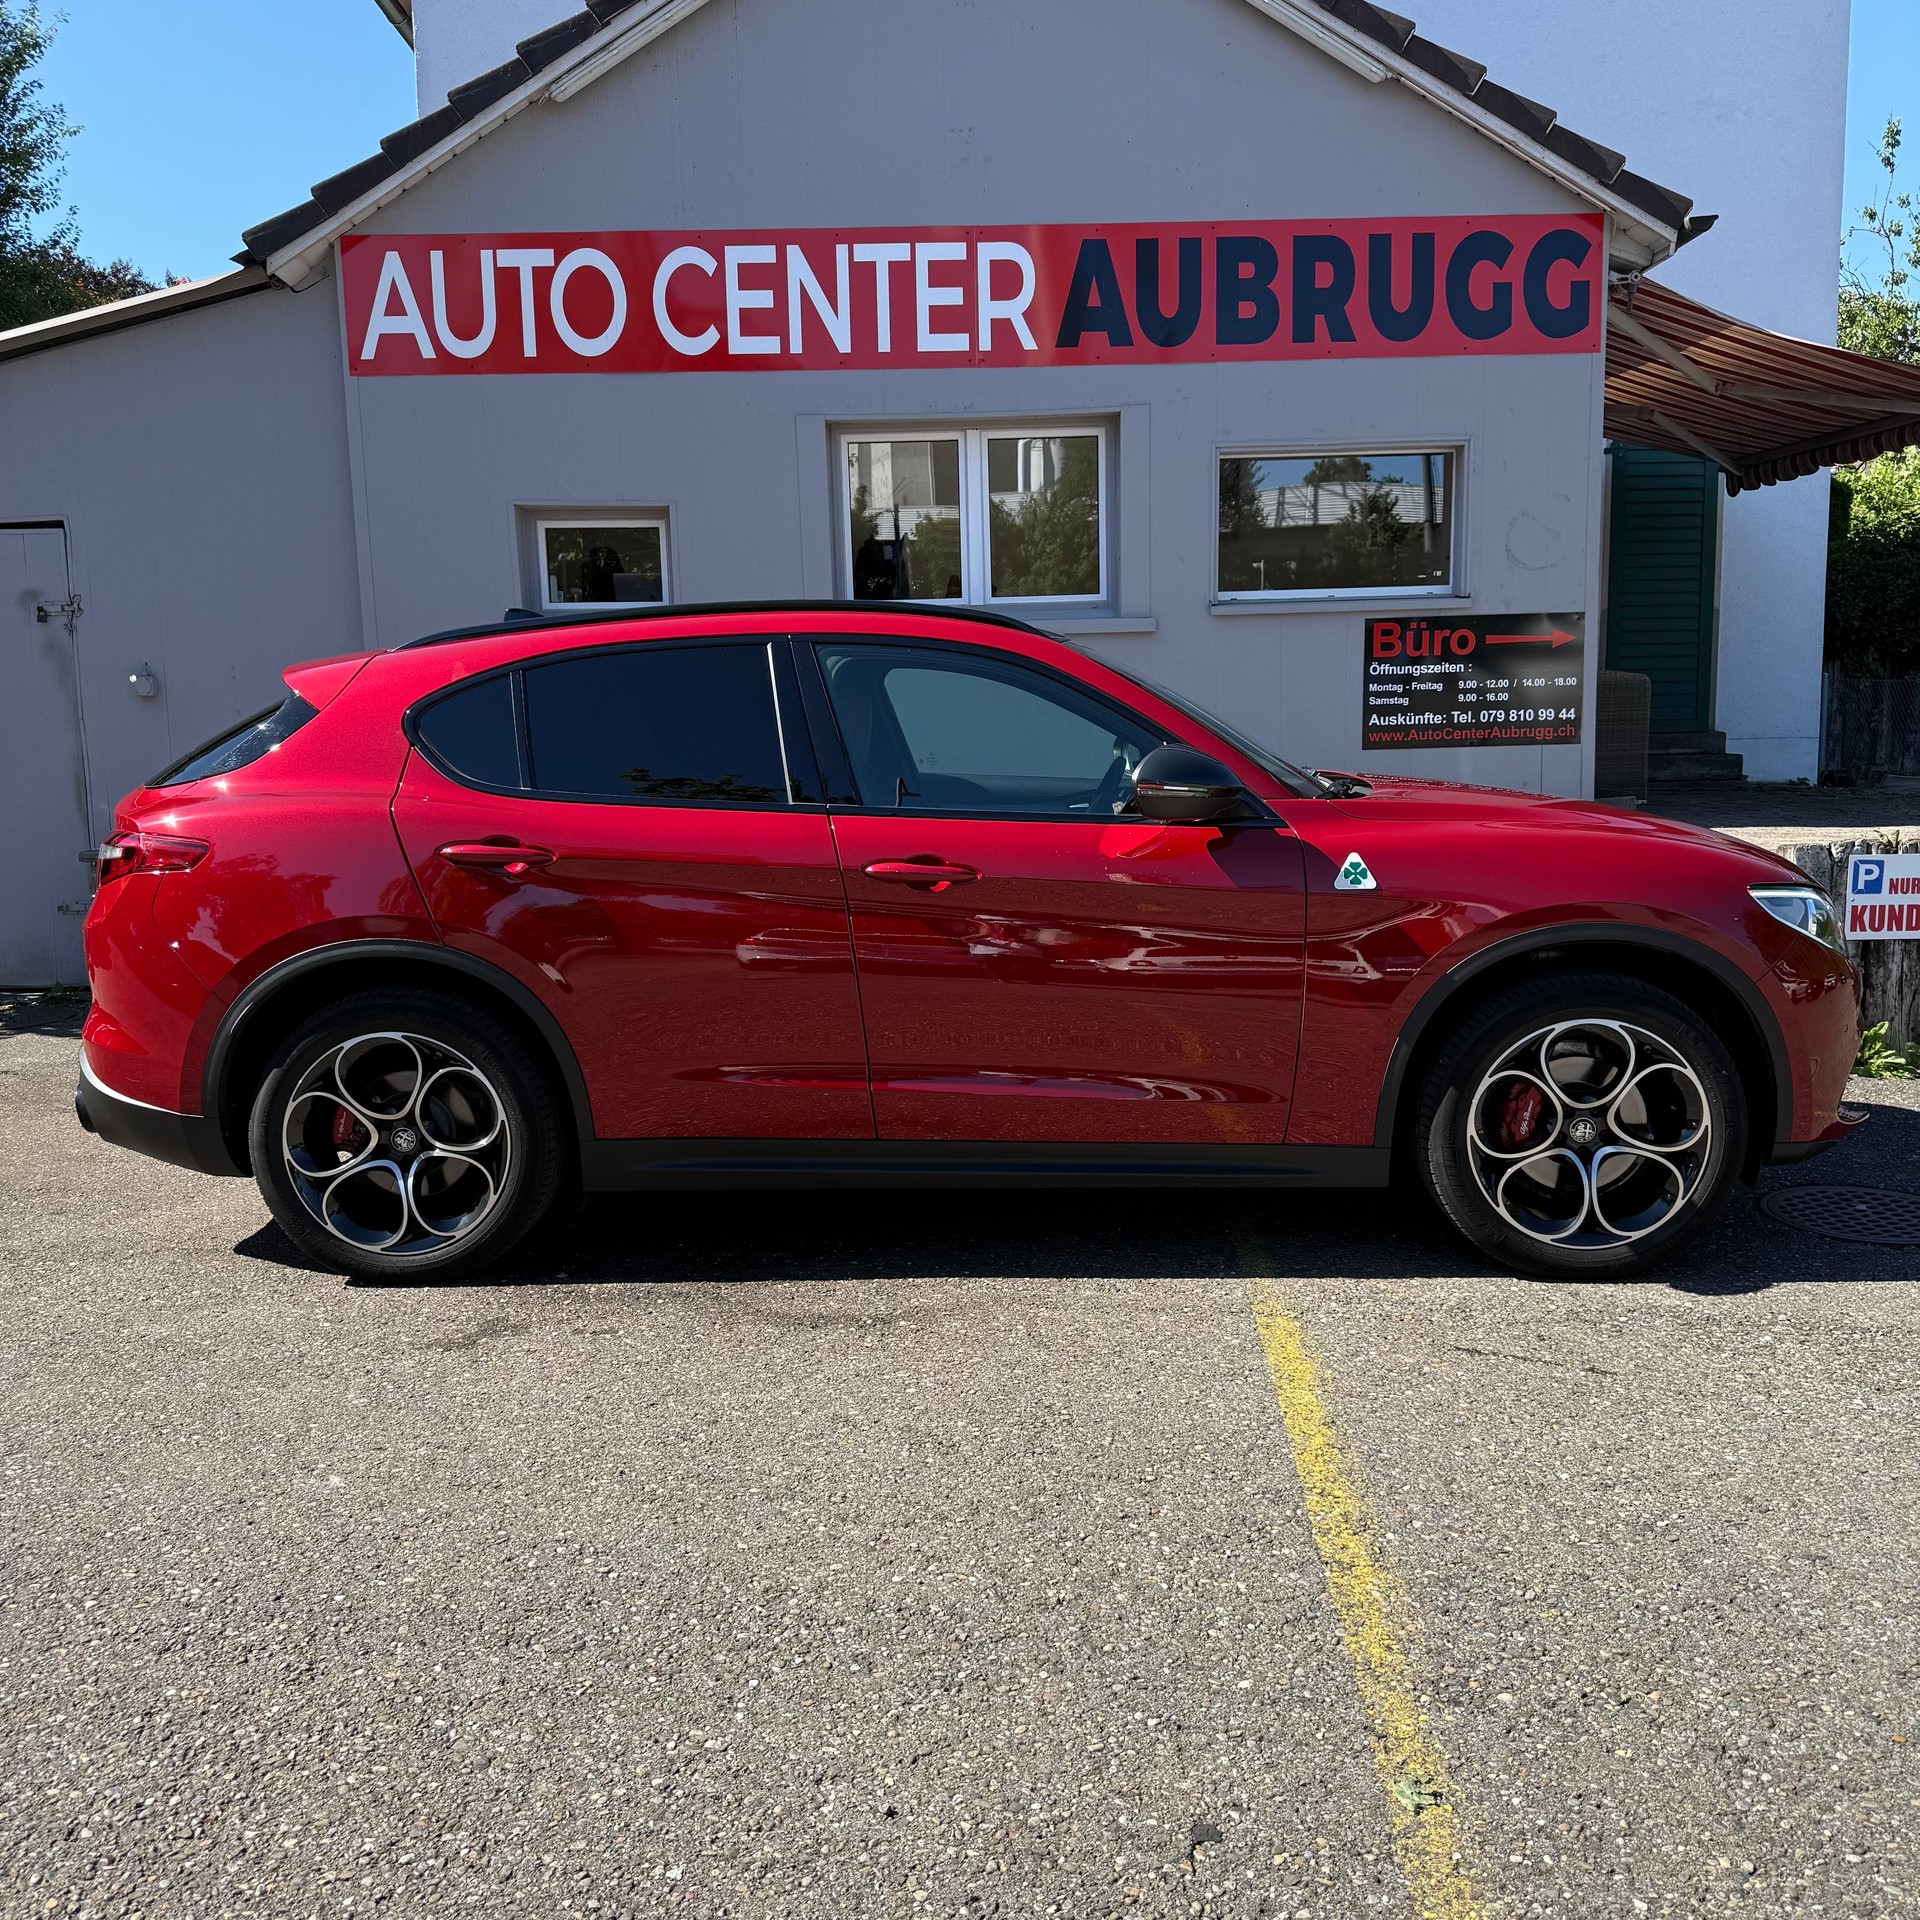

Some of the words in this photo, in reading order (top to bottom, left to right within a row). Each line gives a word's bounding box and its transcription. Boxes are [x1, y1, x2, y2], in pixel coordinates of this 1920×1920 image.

[360, 247, 627, 360] AUTO
[652, 241, 1039, 357] CENTER
[1055, 228, 1593, 348] AUBRUGG
[1372, 621, 1476, 658] Büro
[1369, 661, 1464, 676] Öffnungszeiten
[1369, 682, 1403, 692] Montag
[1411, 681, 1443, 691] Freitag
[1458, 680, 1477, 689] 9.00
[1485, 679, 1509, 688] 12.00
[1522, 678, 1545, 687] 14.00
[1554, 677, 1577, 686] 18.00
[1369, 696, 1409, 706] Samstag
[1458, 693, 1477, 702] 9.00
[1485, 692, 1509, 702] 16.00
[1368, 711, 1447, 726] Auskünfte:
[1451, 711, 1476, 723] Tel.
[1480, 710, 1505, 722] 079
[1509, 709, 1534, 722] 810
[1537, 708, 1555, 721] 99
[1558, 708, 1576, 720] 44
[1368, 724, 1575, 742] www.AutoCenterAubrugg.ch
[1857, 863, 1880, 890] P
[1888, 877, 1920, 895] NUR
[1850, 904, 1920, 932] KUND
